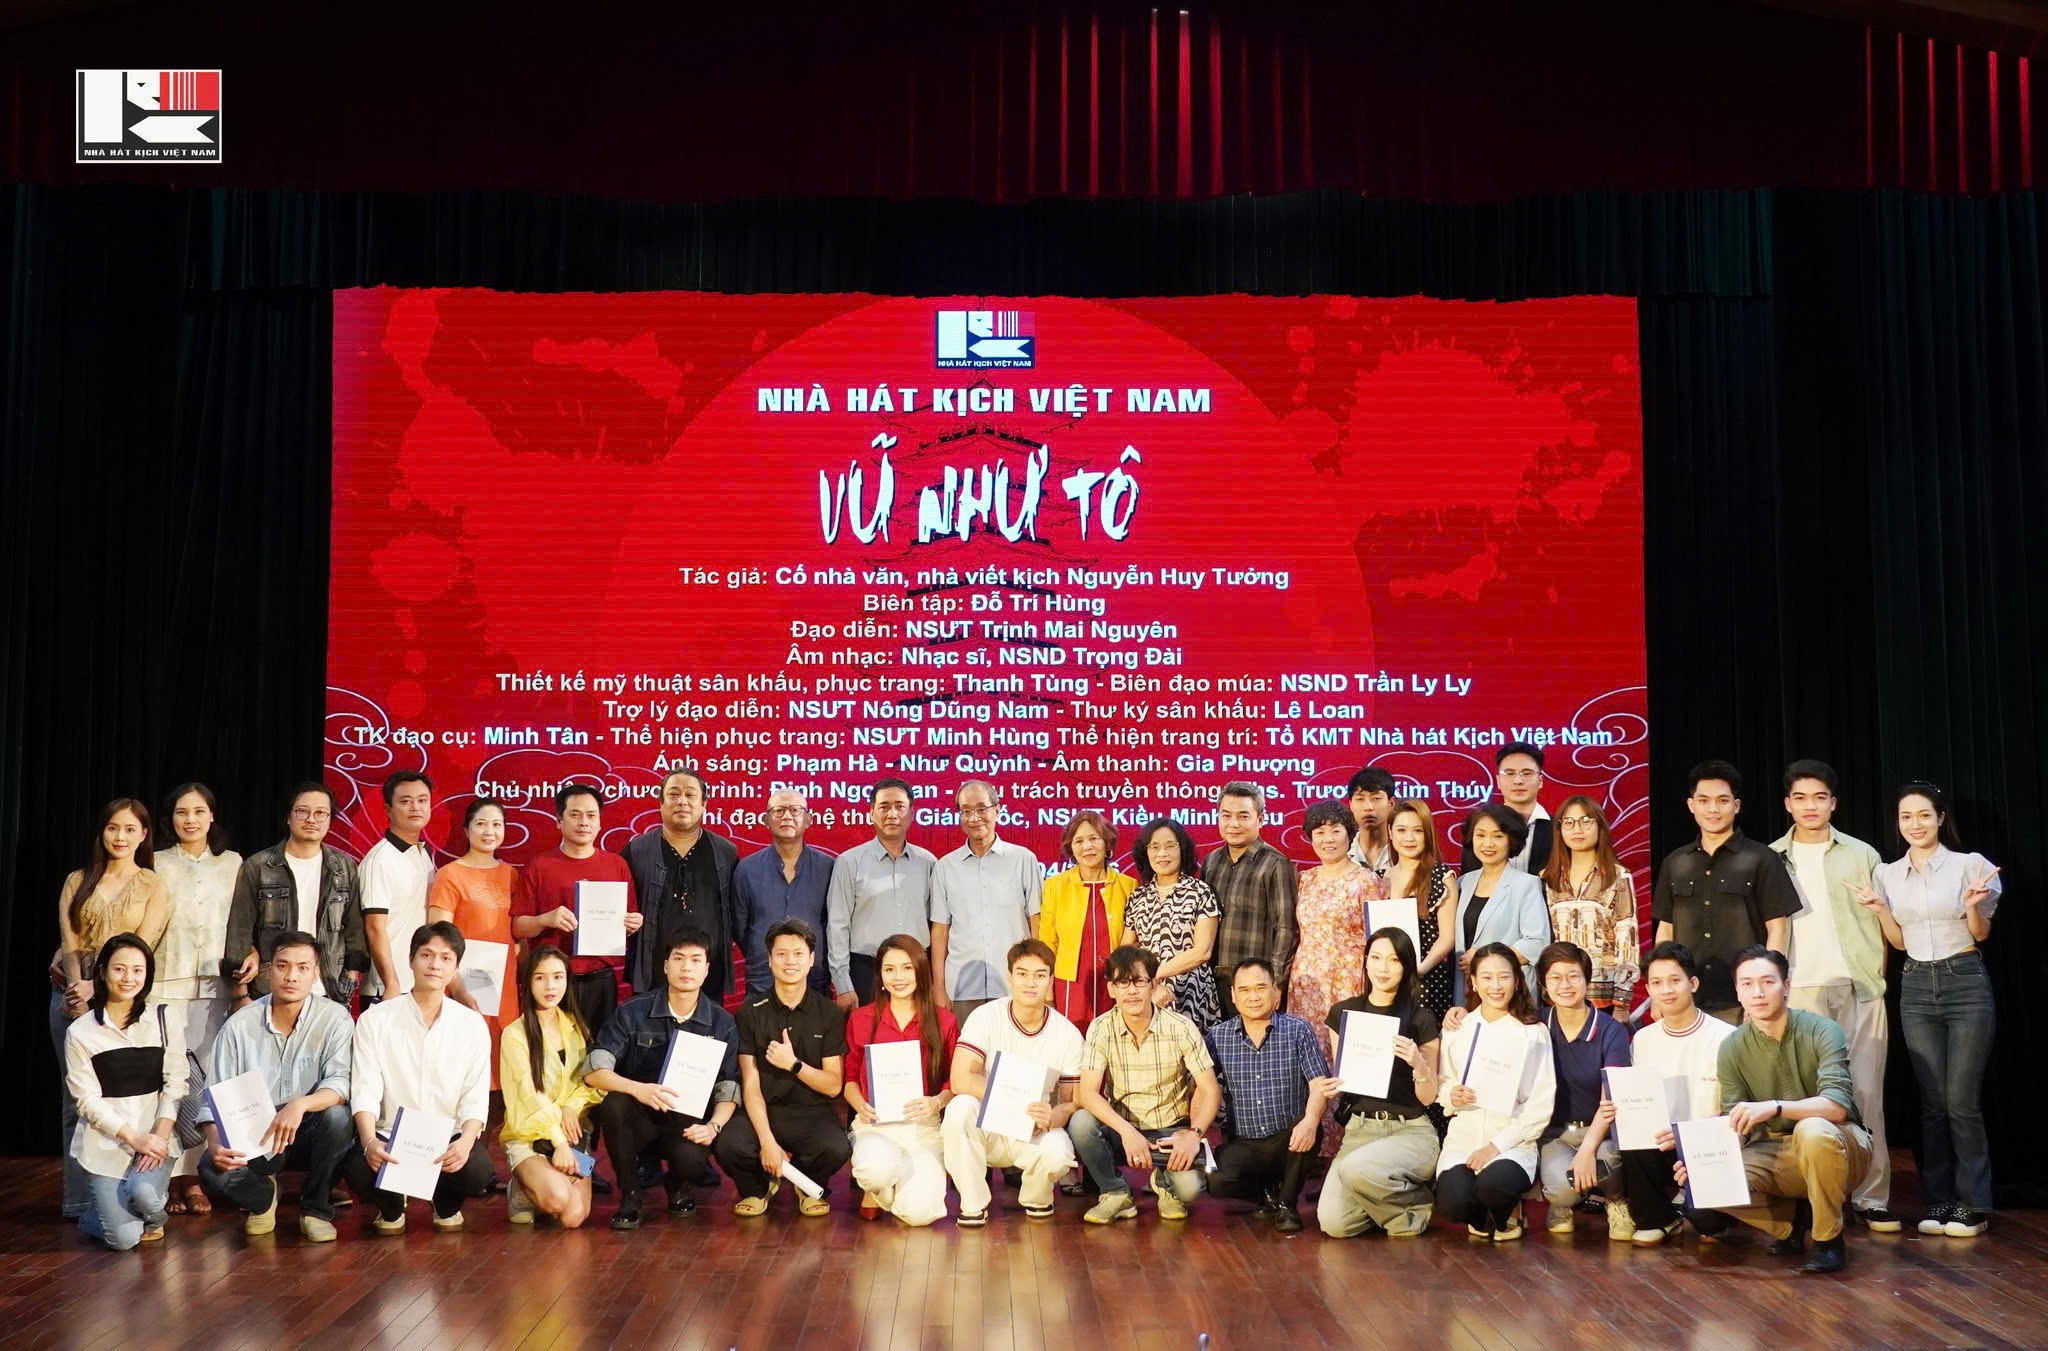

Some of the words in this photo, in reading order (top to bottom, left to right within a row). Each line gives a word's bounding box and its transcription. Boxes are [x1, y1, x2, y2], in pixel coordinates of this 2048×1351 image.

[937, 359, 955, 367] NHÀ
[955, 359, 973, 367] HÁT
[973, 360, 993, 368] KỊCH
[993, 358, 1012, 368] VIỆT
[757, 383, 831, 412] NHÀ
[847, 383, 919, 412] HÁT
[932, 387, 1014, 417] KỊCH
[1028, 383, 1113, 418] VIỆT
[1127, 388, 1211, 413] NAM
[819, 432, 897, 544] VŨ
[918, 443, 1048, 543] NHƯ
[1061, 444, 1142, 541] TÔ
[678, 567, 720, 585] Tác
[727, 567, 768, 589] giả:
[775, 563, 808, 585] Cố
[813, 567, 856, 585] nhà
[862, 567, 910, 588] văn,
[917, 567, 959, 585] nhà
[964, 563, 1008, 585] viết
[1013, 567, 1060, 590] kịch
[1067, 564, 1154, 590] Nguyễn
[1160, 567, 1206, 590] Huy
[1211, 567, 1289, 590] Tưởng
[863, 593, 914, 611] Biên
[920, 593, 964, 616] tập:
[970, 591, 1003, 612] Đỗ
[1009, 593, 1039, 612] Trí
[1045, 593, 1106, 617] Hùng
[789, 620, 836, 642] Đạo
[842, 617, 898, 638] diễn:
[906, 620, 974, 639] NSƯT
[979, 620, 1038, 643] Trịnh
[1044, 620, 1084, 639] Mai
[1091, 620, 1178, 643] Nguyên
[786, 643, 824, 665] Âm
[831, 647, 893, 669] nhạc:
[901, 646, 960, 669] Nhạc
[965, 647, 992, 668] sĩ,
[999, 647, 1067, 666] NSND
[1072, 647, 1139, 670] Trọng
[1144, 647, 1182, 666] Đài
[495, 669, 553, 692] Thiết
[560, 669, 586, 692] kế
[593, 673, 627, 696] mỹ
[633, 673, 693, 695] thuật
[698, 673, 739, 692] sân
[747, 670, 808, 695] khấu,
[815, 673, 873, 696] phục
[878, 674, 945, 697] trang:
[952, 673, 1024, 692] Thanh
[1030, 673, 1089, 697] Tùng
[1110, 673, 1161, 692] Biên
[1168, 673, 1211, 696] đạo
[1217, 673, 1273, 692] múa:
[1281, 673, 1348, 692] NSND
[1353, 670, 1404, 692] Trần
[1411, 673, 1439, 697] Ly
[1445, 673, 1472, 697] Ly
[602, 700, 644, 722] Trợ
[650, 700, 669, 723] lý
[675, 700, 718, 722] đạo
[725, 697, 780, 719] diễn:
[789, 700, 857, 719] NSƯT
[863, 700, 923, 723] Nông
[930, 700, 991, 723] Dũng
[998, 700, 1049, 719] Nam
[1070, 700, 1118, 719] Thư
[1123, 700, 1150, 723] ký
[1156, 700, 1196, 719] sân
[1204, 697, 1266, 719] khấu:
[1274, 700, 1302, 719] Lê
[1308, 700, 1365, 719] Loan
[353, 726, 387, 745] TK
[391, 726, 435, 749] đạo
[441, 731, 477, 749] cụ:
[484, 726, 539, 745] Minh
[545, 726, 589, 746] Tân
[609, 723, 653, 745] Thể
[660, 727, 708, 749] hiện
[715, 727, 772, 749] phục
[778, 728, 845, 749] trang:
[853, 727, 921, 746] NSƯT
[927, 727, 983, 746] Minh
[989, 727, 1050, 749] Hùng
[1056, 723, 1099, 746] Thể
[1106, 727, 1154, 749] hiện
[1160, 728, 1220, 749] trang
[1227, 727, 1258, 746] trí:
[1264, 723, 1295, 746] Tổ
[1302, 727, 1353, 746] KMT
[1359, 727, 1405, 746] Nhà
[1411, 727, 1448, 746] hát
[1453, 727, 1505, 749] Kịch
[1510, 727, 1556, 749] Việt
[1560, 727, 1613, 746] Nam
[652, 749, 700, 772] Ánh
[706, 753, 768, 776] sáng:
[777, 753, 841, 776] Phạm
[848, 753, 879, 773] Hà
[900, 753, 950, 773] Như
[955, 753, 1031, 777] Quỳnh
[1051, 749, 1090, 772] Âm
[1096, 754, 1169, 773] thanh:
[1176, 754, 1215, 773] Gia
[1222, 754, 1316, 777] Phượng
[474, 780, 520, 799] Chủ
[705, 780, 762, 799] trình:
[830, 780, 875, 803] Ngọ
[912, 785, 938, 799] an
[1011, 780, 1070, 799] trách
[1075, 777, 1150, 803] truyền
[1155, 780, 1224, 803] thông
[1435, 780, 1494, 803] Thúy
[702, 807, 722, 825] hỉ
[915, 807, 960, 826] Giá
[1000, 804, 1031, 829] ốc,
